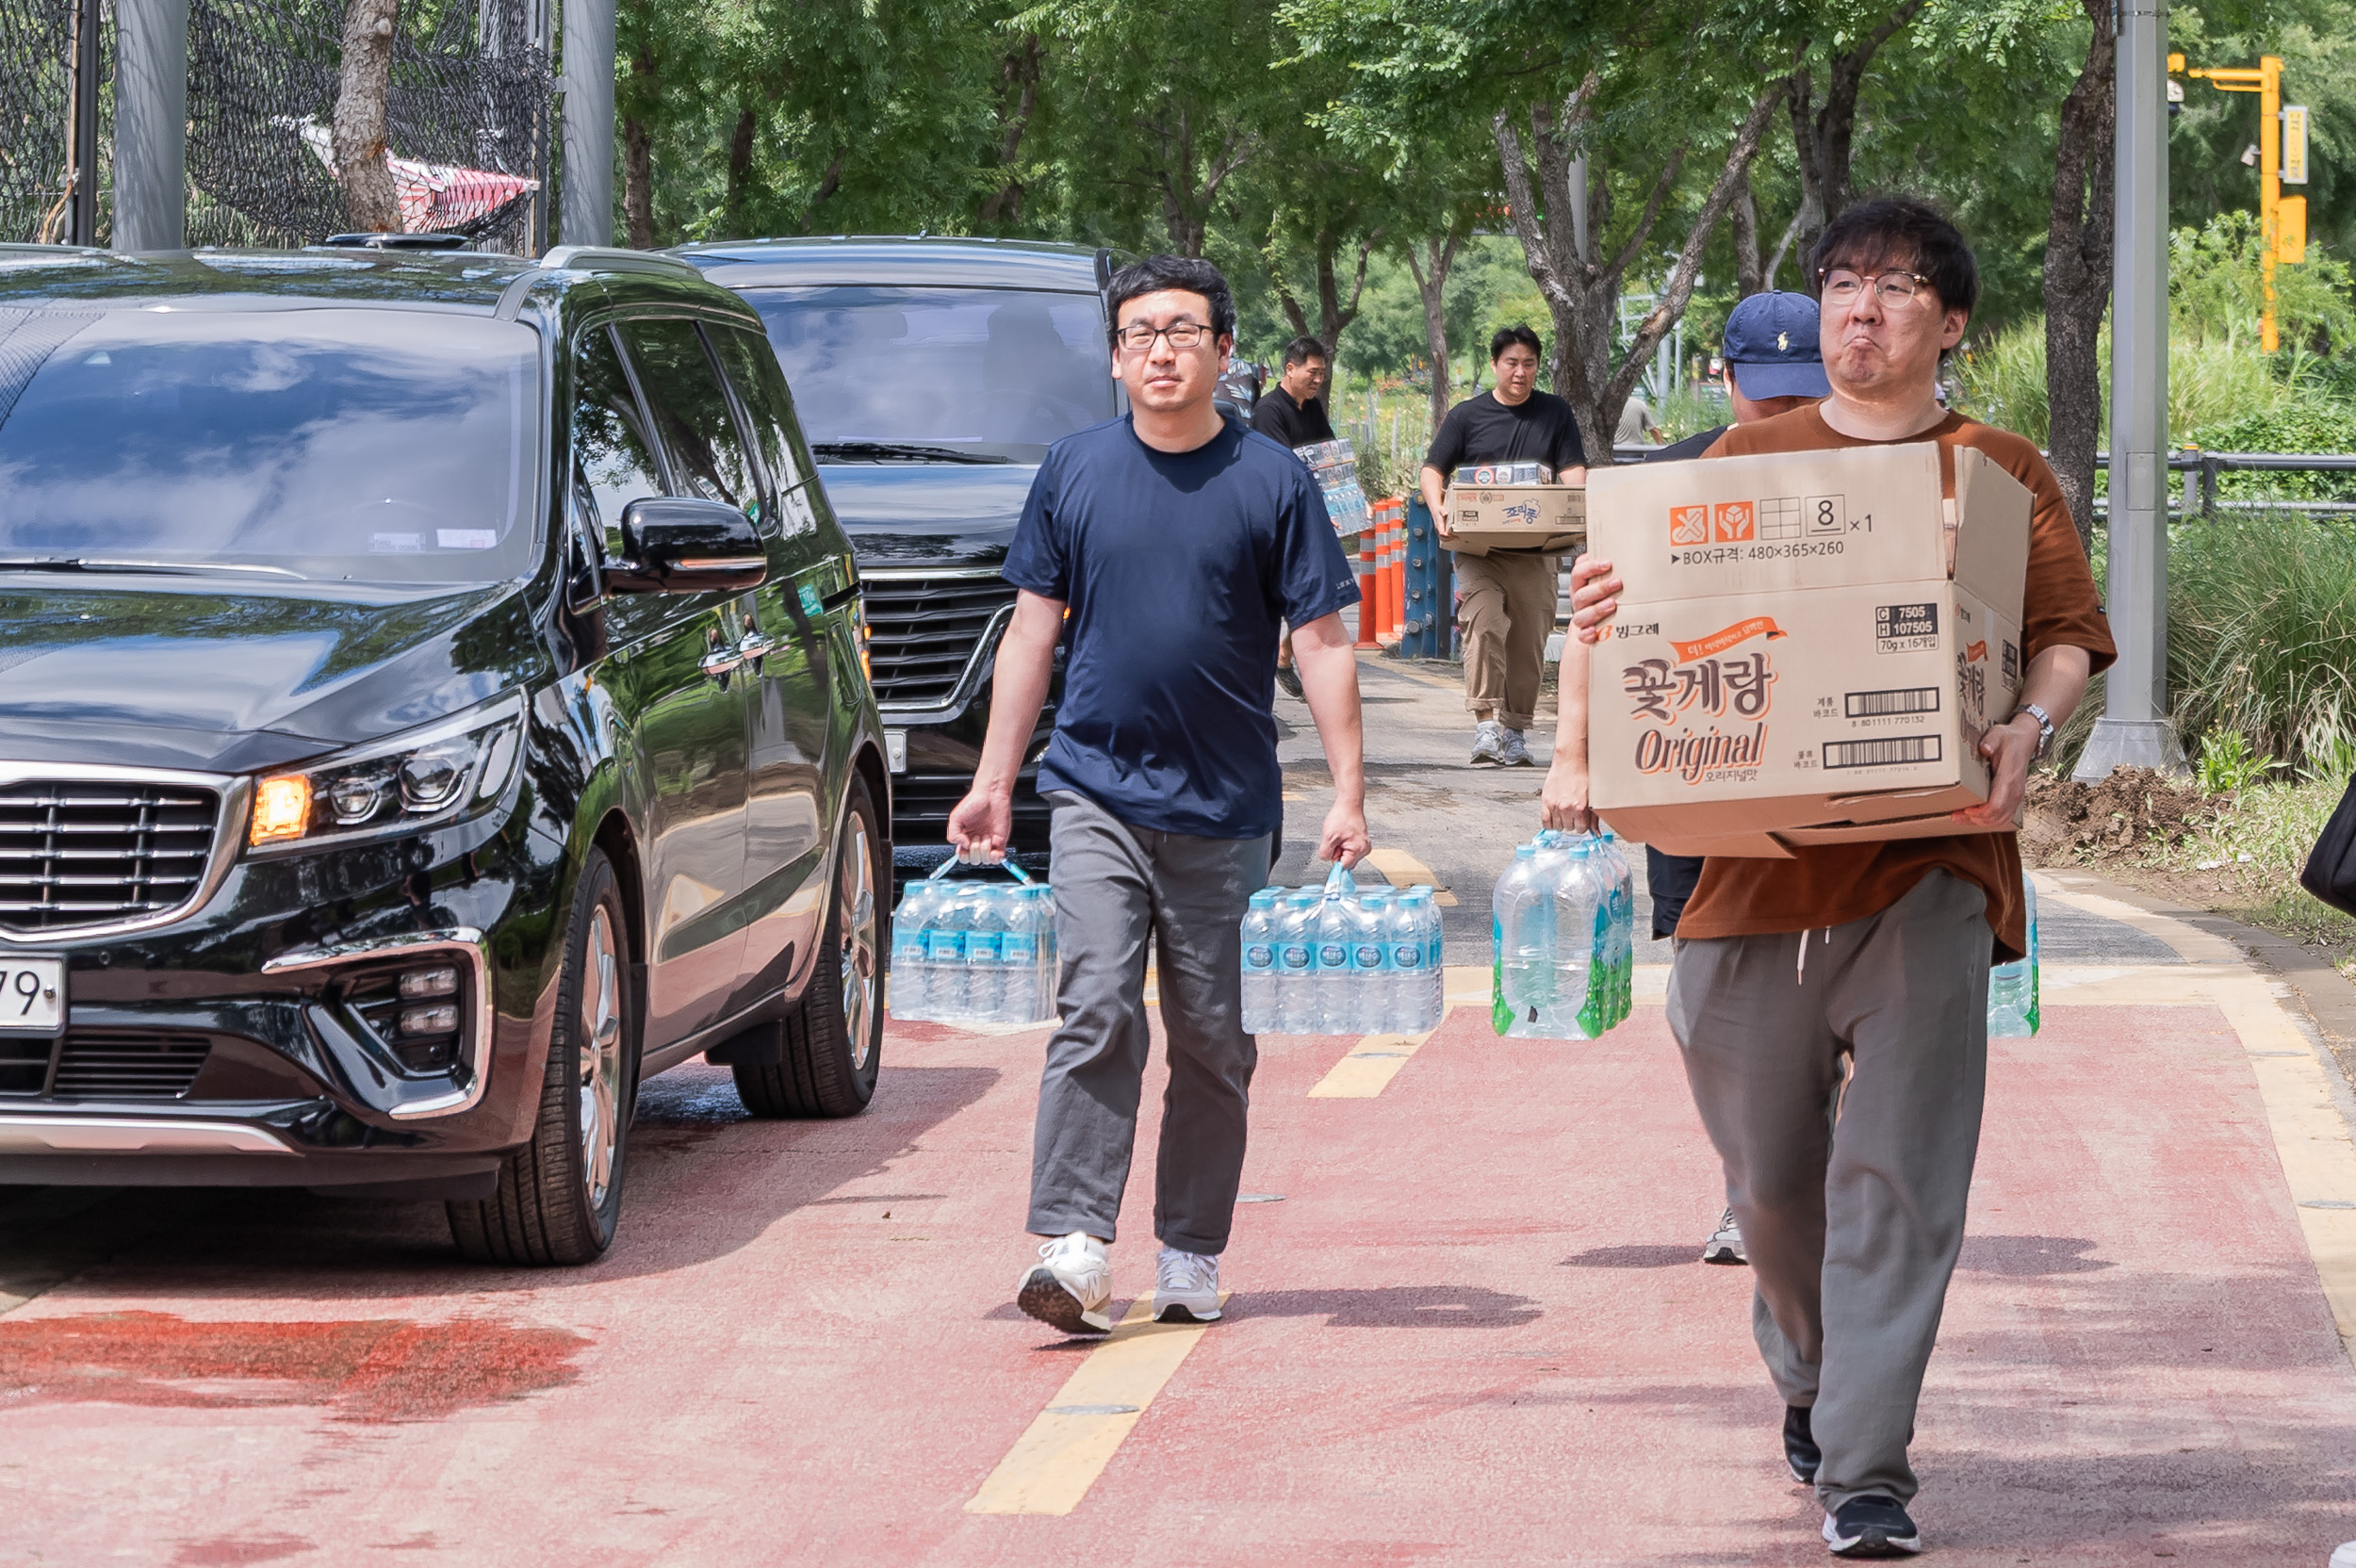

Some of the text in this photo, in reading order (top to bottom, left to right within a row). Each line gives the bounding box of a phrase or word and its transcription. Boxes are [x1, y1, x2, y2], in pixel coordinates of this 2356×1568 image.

[1817, 499, 1835, 526] 8
[1683, 547, 1744, 565] BOX규격:
[1898, 606, 1926, 619] 7505
[1616, 622, 1660, 640] 빙그레
[1893, 621, 1933, 635] 107505
[1880, 640, 1898, 652] 70g
[1622, 653, 1775, 722] 꽃게랑
[1635, 722, 1766, 783] Original
[1705, 769, 1758, 783] 오리지널맛
